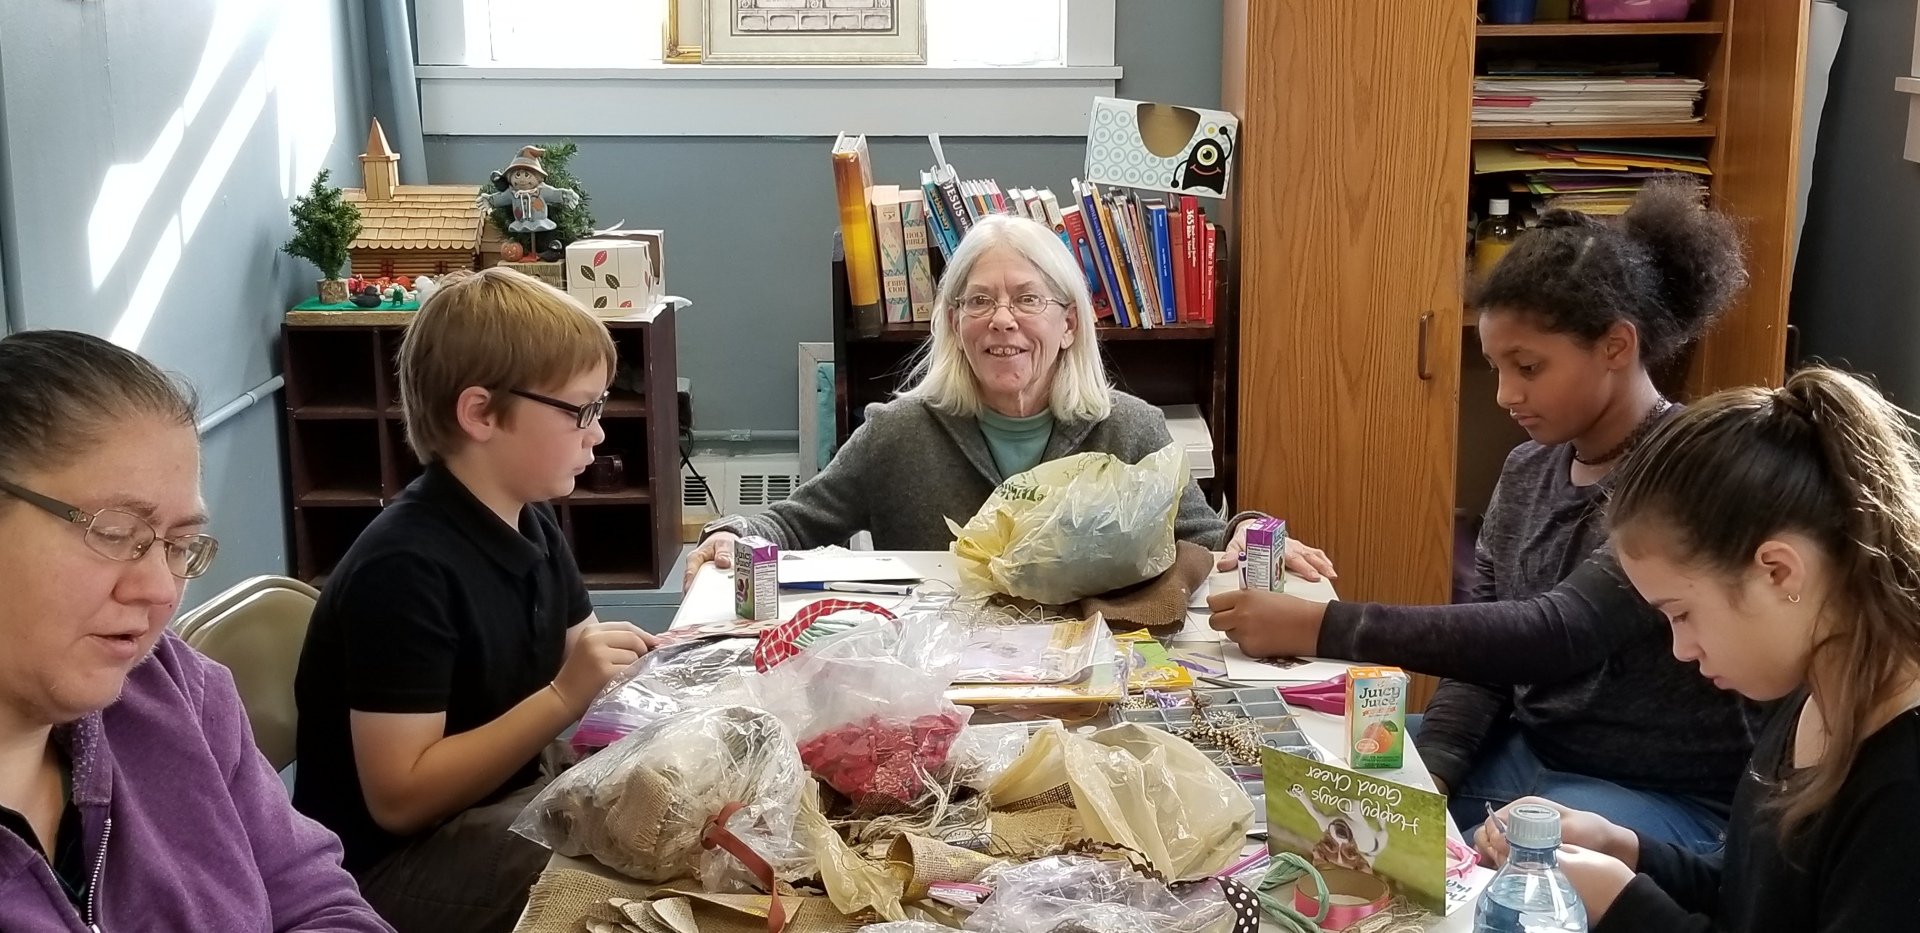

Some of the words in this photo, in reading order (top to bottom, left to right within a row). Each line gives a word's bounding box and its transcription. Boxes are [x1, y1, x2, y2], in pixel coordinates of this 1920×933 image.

[942, 183, 965, 217] JESUS
[1186, 208, 1194, 225] 365
[1359, 686, 1401, 699] Juicy
[1361, 698, 1396, 708] Juice
[1304, 765, 1352, 792] Cheer
[1356, 778, 1402, 806] Good
[1311, 786, 1354, 814] Days
[1360, 798, 1420, 835] Happy
[1446, 891, 1467, 902] Th
